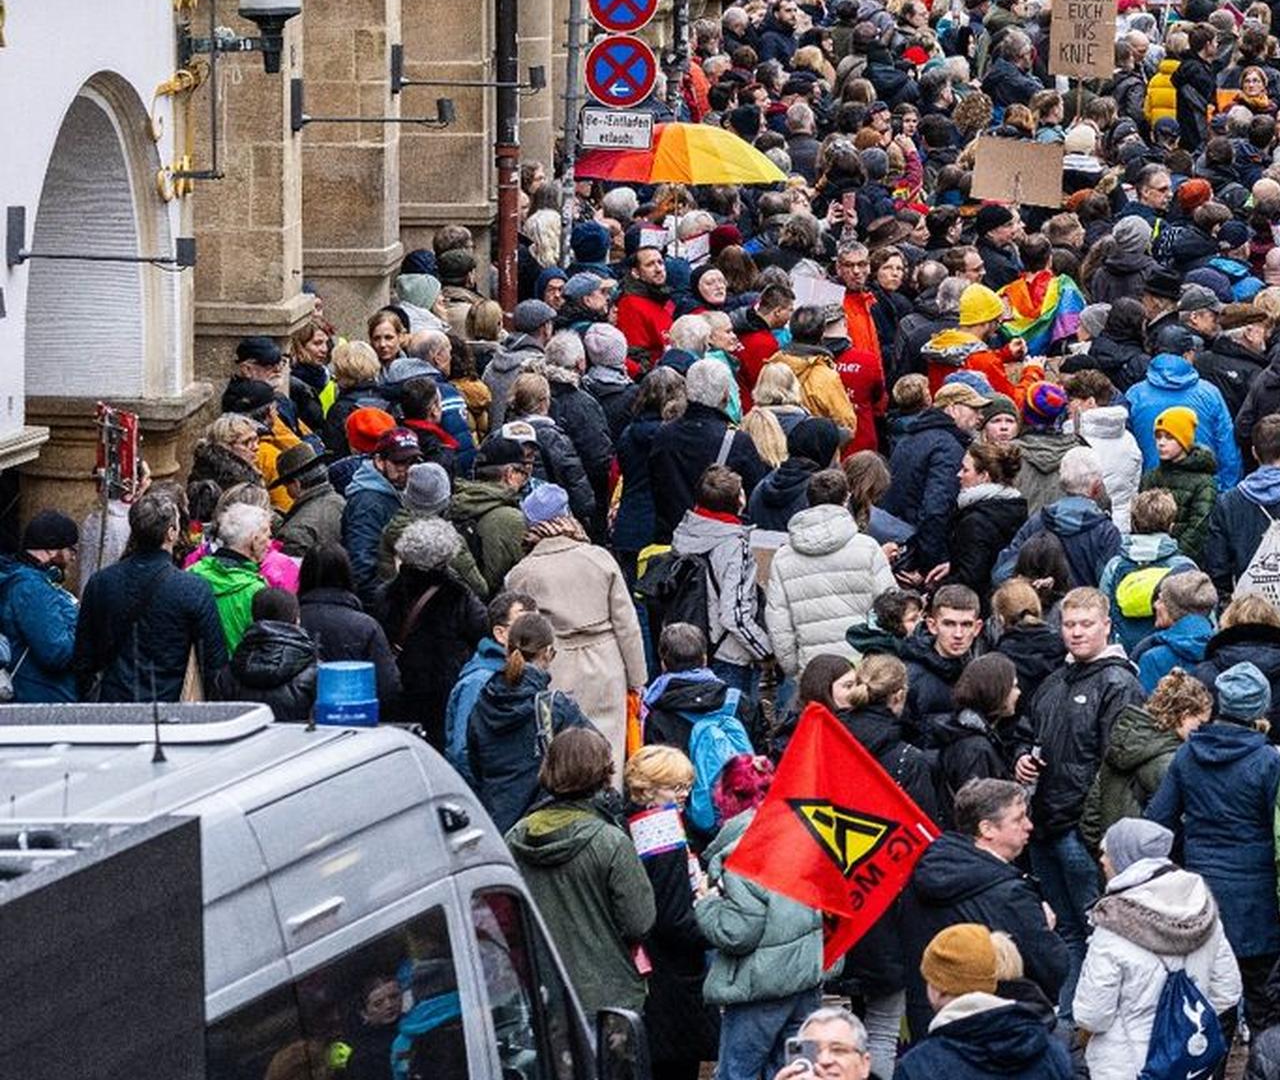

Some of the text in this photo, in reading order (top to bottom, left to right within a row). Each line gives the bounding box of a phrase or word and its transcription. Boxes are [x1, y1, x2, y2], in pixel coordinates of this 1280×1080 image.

[1068, 3, 1103, 20] EUCH
[1074, 21, 1097, 41] INS
[1060, 42, 1100, 65] KNIE
